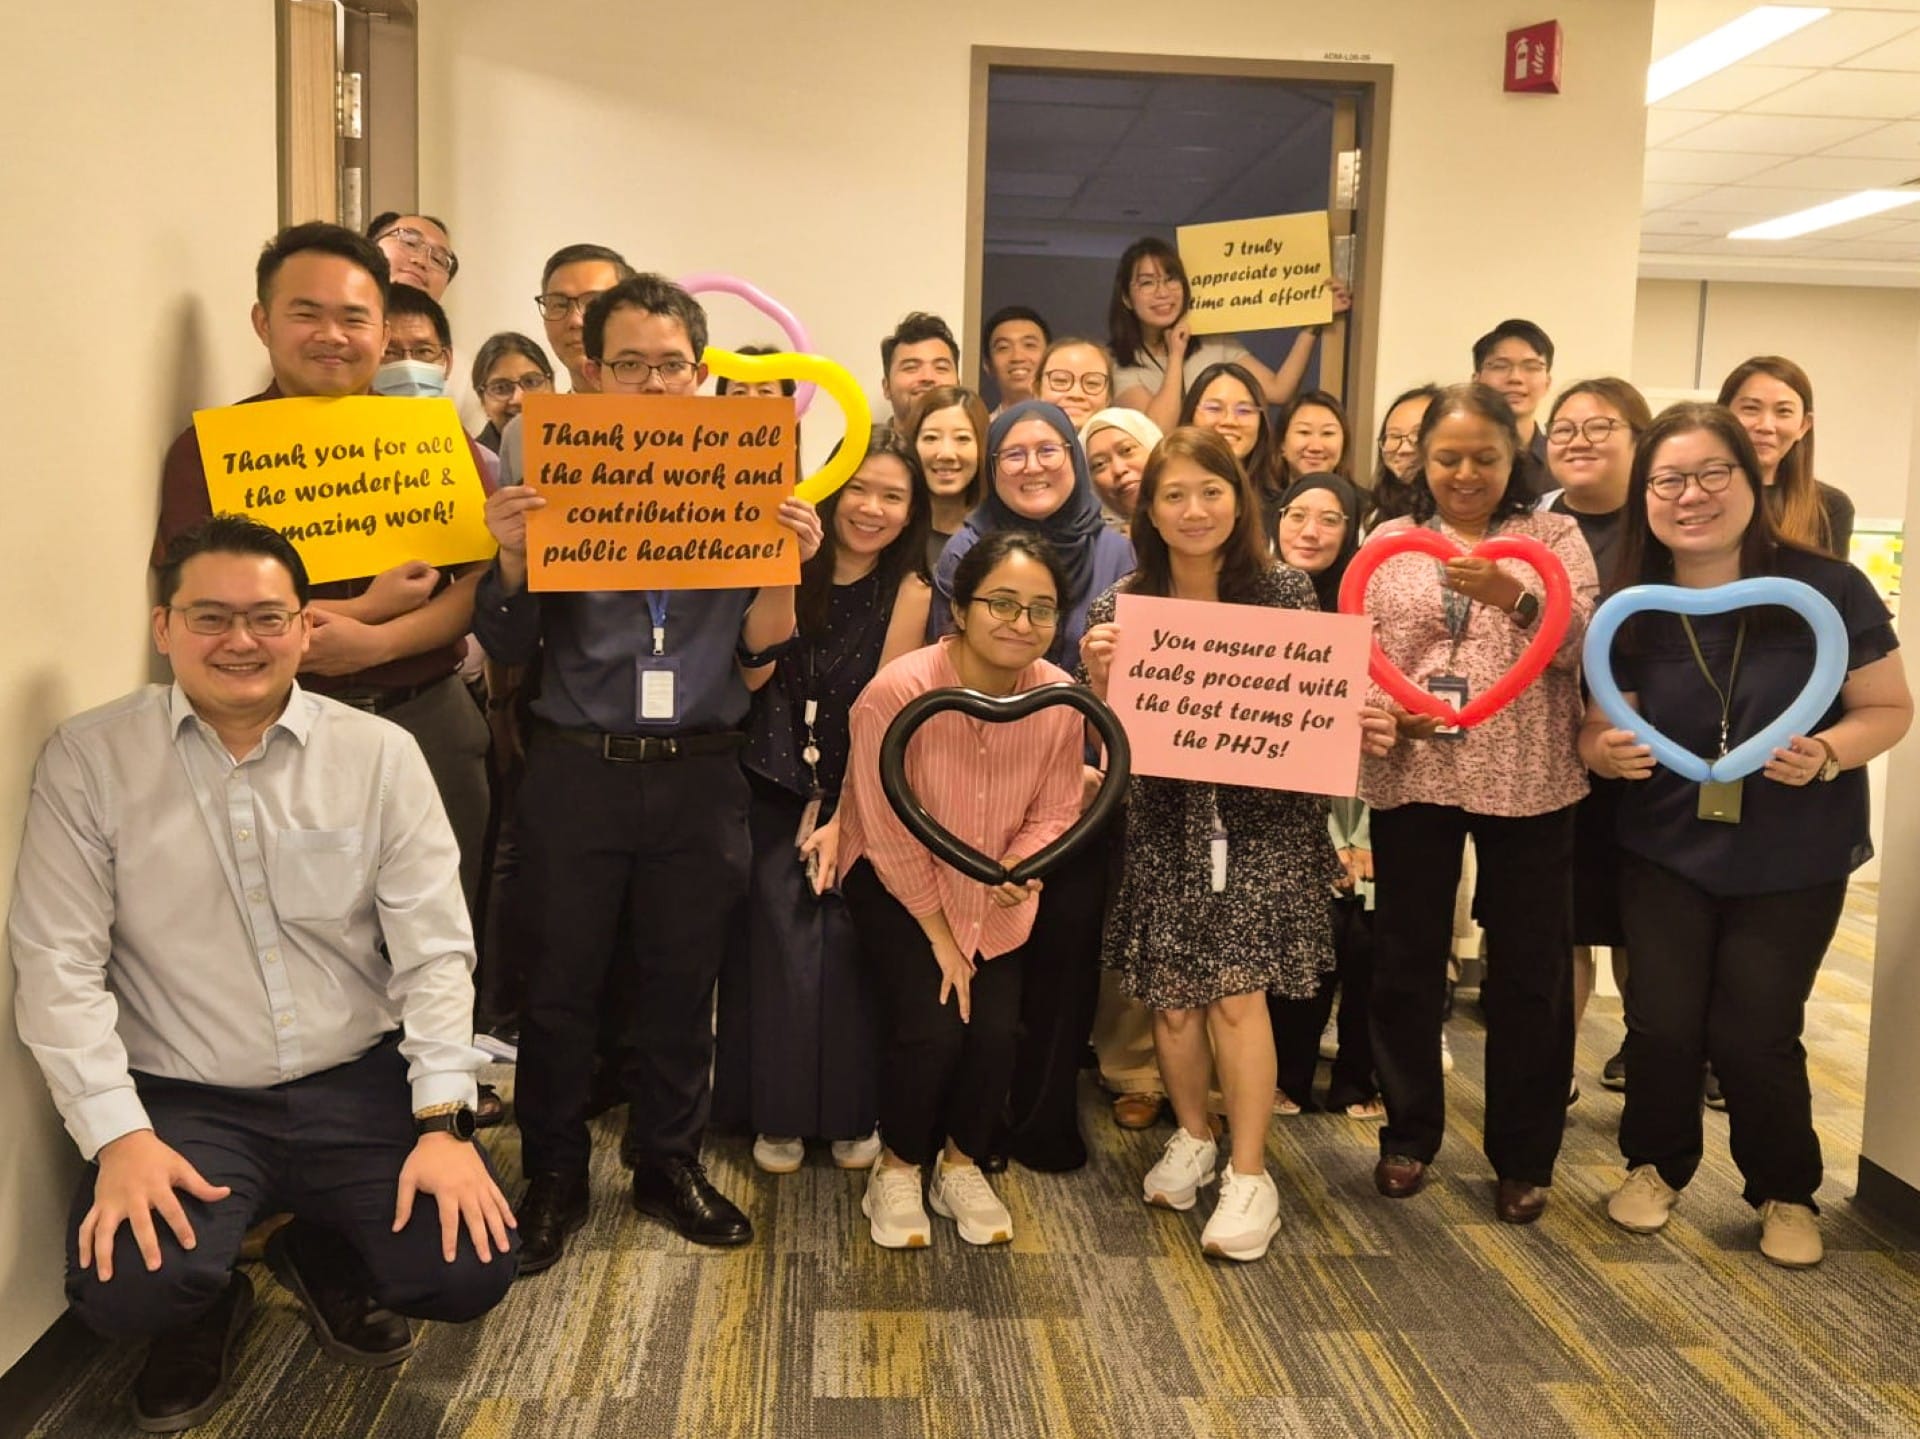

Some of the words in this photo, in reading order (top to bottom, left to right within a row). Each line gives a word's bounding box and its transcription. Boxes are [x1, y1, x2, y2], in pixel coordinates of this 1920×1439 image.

[1224, 242, 1235, 257] I
[1241, 238, 1284, 256] truly
[1191, 263, 1278, 287] appreciate
[1282, 262, 1321, 279] your
[1189, 295, 1224, 310] time
[1230, 289, 1263, 306] and
[1269, 284, 1326, 305] effort!
[542, 422, 625, 451] Thank
[633, 429, 684, 451] you
[692, 425, 729, 452] for
[737, 425, 782, 447] all
[223, 443, 307, 474] Thank
[315, 443, 365, 467] you
[374, 437, 407, 461] for
[416, 436, 454, 454] all
[244, 485, 286, 508] the
[295, 468, 430, 502] wonderful
[441, 467, 456, 486] &
[540, 462, 583, 485] the
[591, 461, 654, 485] hard
[663, 463, 727, 489] work
[734, 462, 783, 485] and
[281, 512, 377, 542] mazing
[385, 500, 455, 528] work!
[566, 500, 726, 524] contribution
[734, 501, 761, 522] to
[543, 538, 627, 567] public
[636, 537, 785, 562] healthcare!
[1151, 628, 1196, 653] You
[1202, 637, 1276, 658] ensure
[1284, 640, 1333, 664] that
[1128, 659, 1195, 685] deals
[1202, 670, 1292, 693] proceed
[1299, 677, 1349, 699] with
[1135, 692, 1169, 713] the
[1176, 696, 1223, 720] best
[1229, 702, 1293, 728] terms
[1299, 710, 1335, 732] for
[1172, 729, 1207, 748] the
